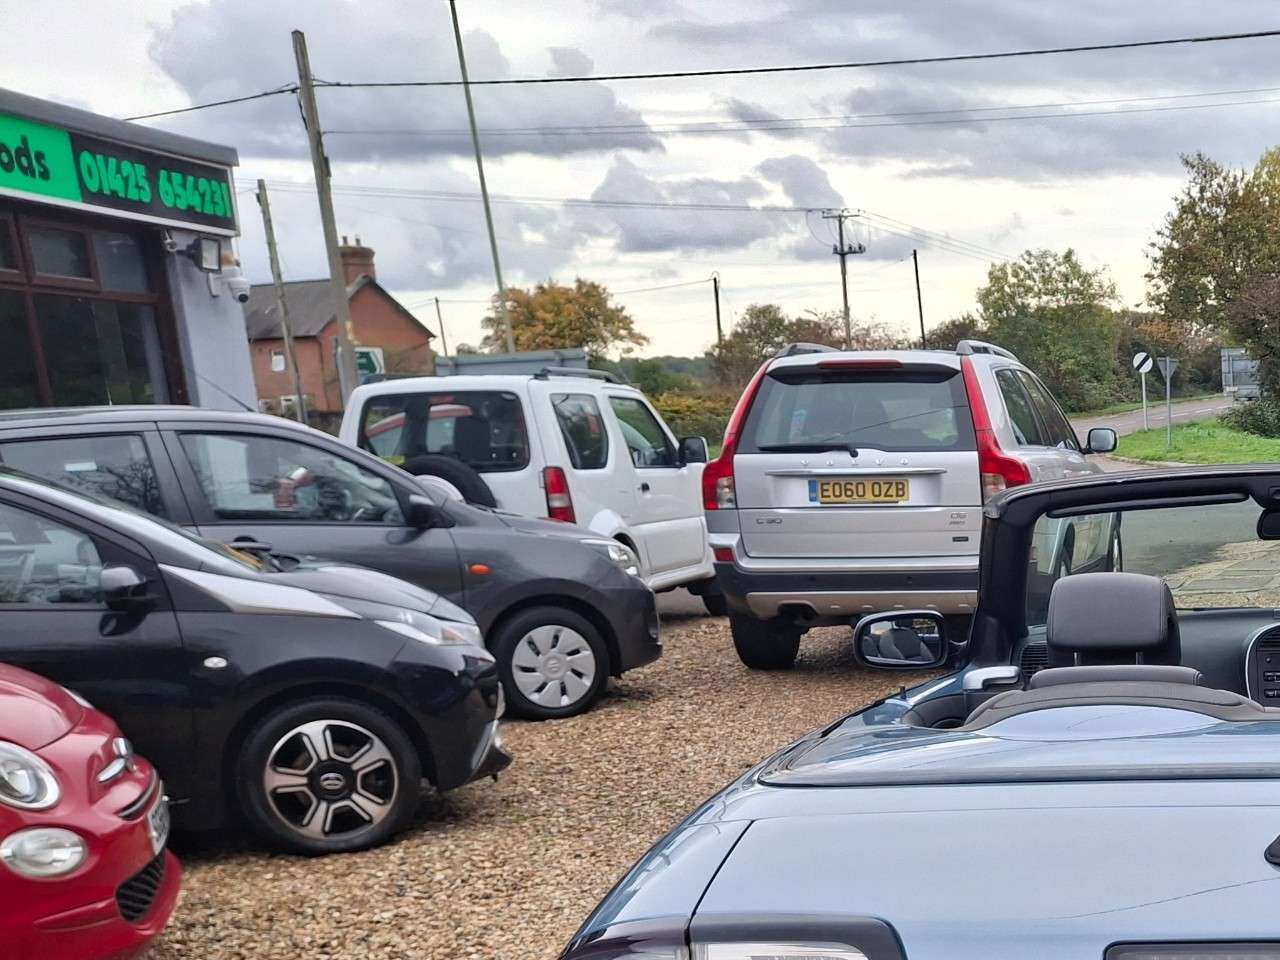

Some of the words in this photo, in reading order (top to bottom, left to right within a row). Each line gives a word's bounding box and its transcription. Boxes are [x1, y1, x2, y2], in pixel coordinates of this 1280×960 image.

[79, 150, 151, 204] 01425
[158, 168, 233, 219] 654231
[820, 481, 866, 499] EO60
[871, 481, 906, 498] OZB
